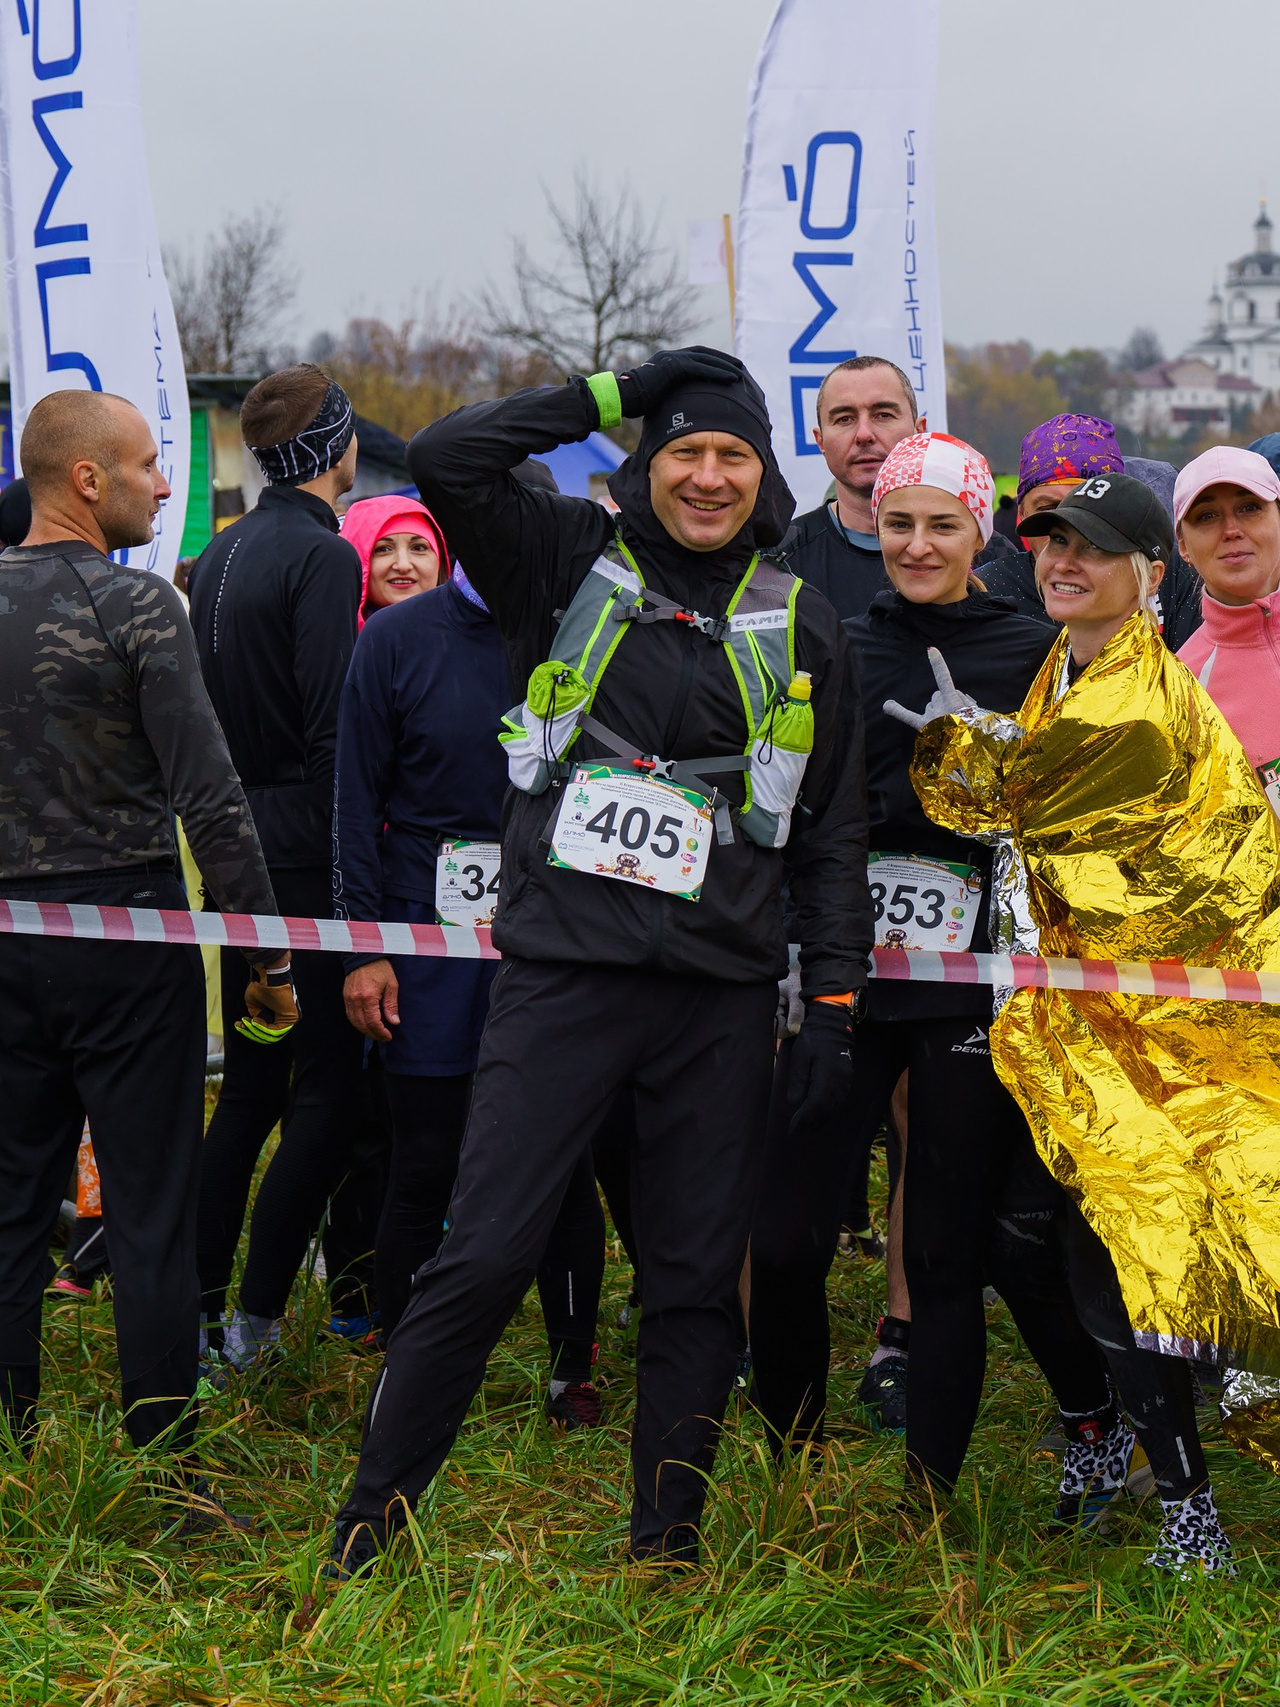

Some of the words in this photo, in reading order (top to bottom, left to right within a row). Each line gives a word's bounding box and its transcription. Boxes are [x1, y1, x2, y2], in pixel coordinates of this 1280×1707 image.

[903, 130, 927, 392] ЦЕННОСТЕЙ
[667, 421, 694, 435] salomon
[1074, 478, 1112, 500] 13
[585, 801, 684, 859] 405
